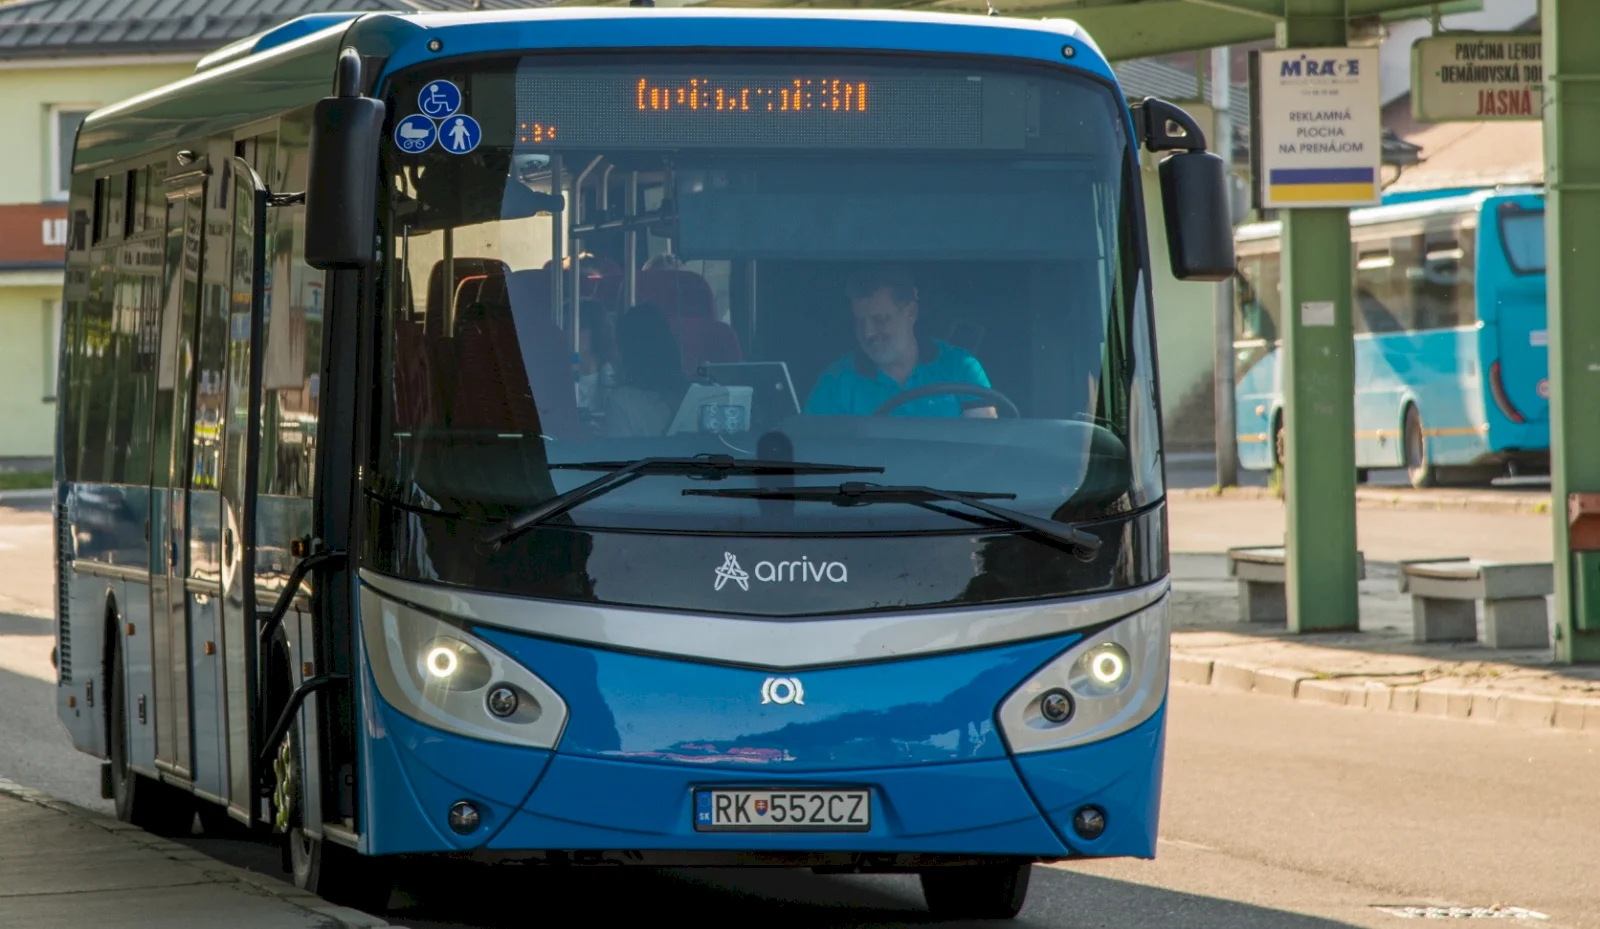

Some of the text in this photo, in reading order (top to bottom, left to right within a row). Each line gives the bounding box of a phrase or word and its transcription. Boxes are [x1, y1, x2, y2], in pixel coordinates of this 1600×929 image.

[1455, 40, 1504, 60] PAVČINA
[1476, 84, 1532, 115] JASNÁ
[1289, 107, 1351, 121] REKLAMNÁ
[1296, 127, 1344, 138] PLOCHA
[1278, 140, 1363, 154] NA PRENÁJOM
[754, 555, 848, 583] arriva
[699, 811, 710, 821] SK
[715, 794, 863, 823] RK 552CZ
